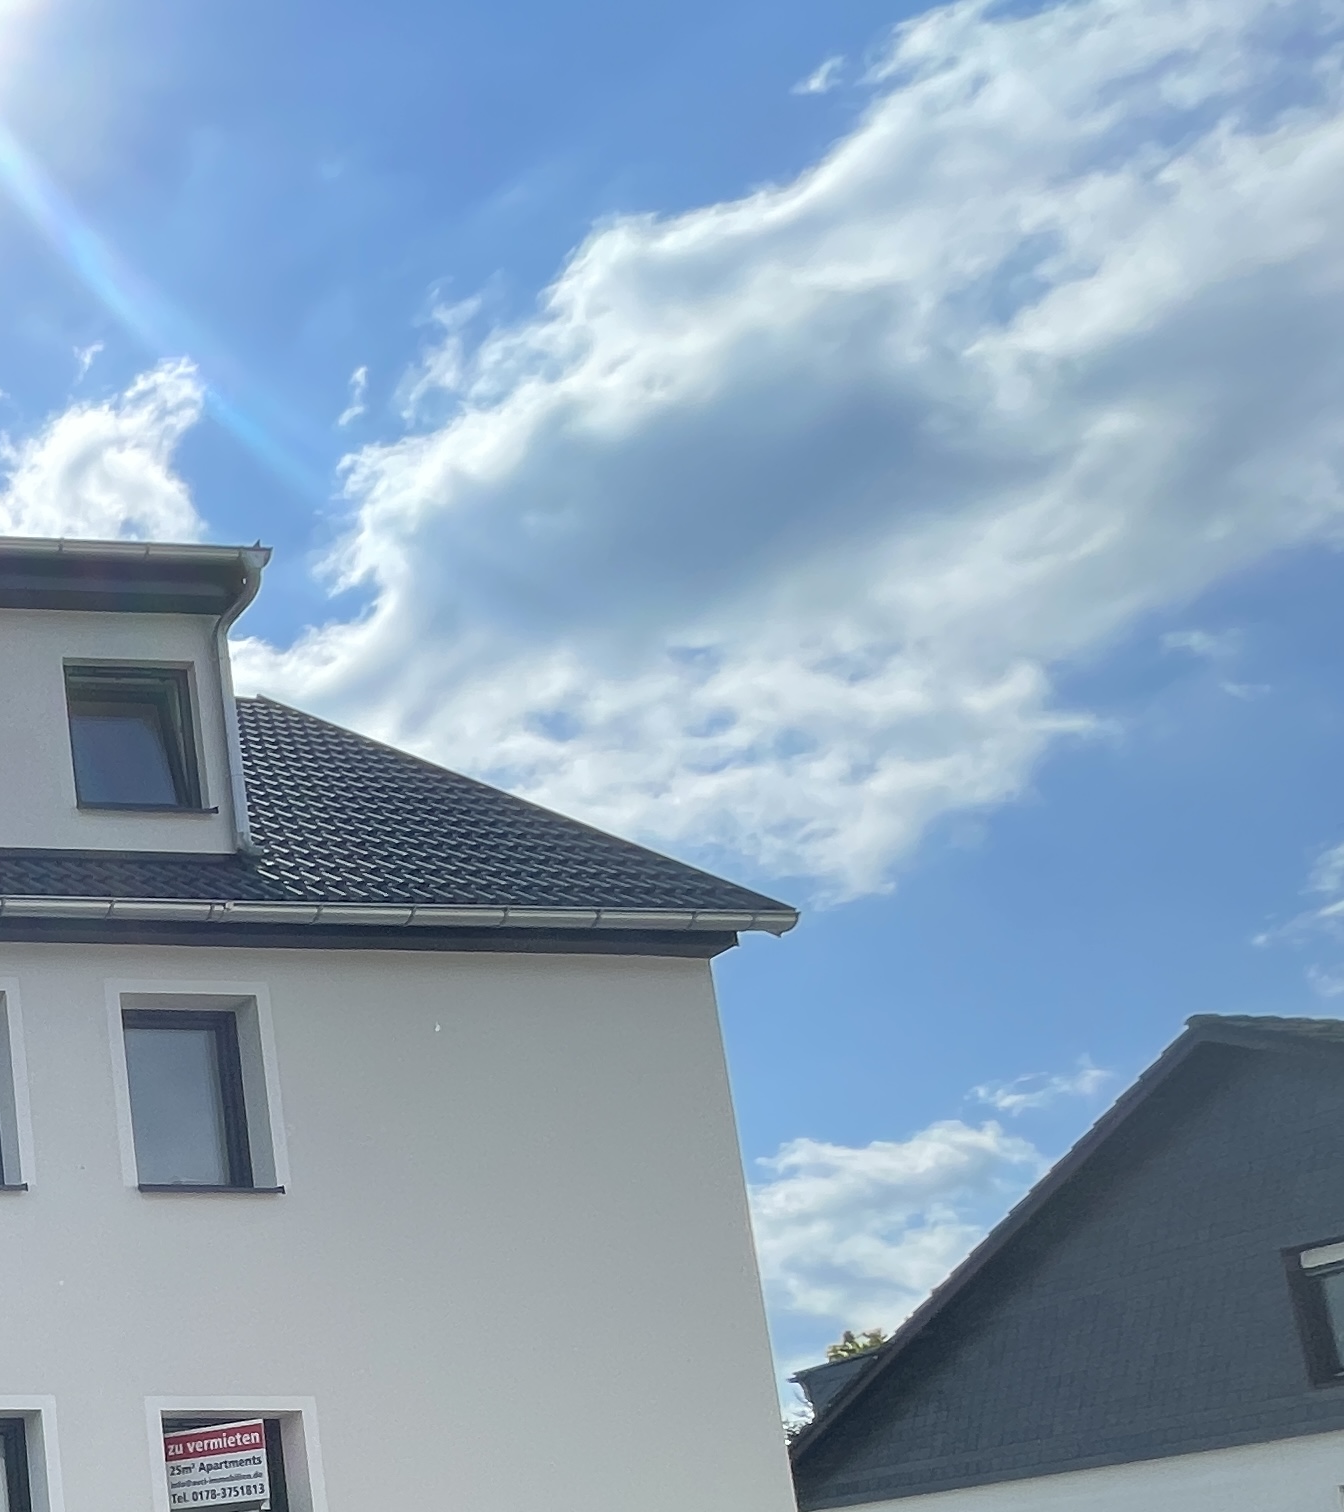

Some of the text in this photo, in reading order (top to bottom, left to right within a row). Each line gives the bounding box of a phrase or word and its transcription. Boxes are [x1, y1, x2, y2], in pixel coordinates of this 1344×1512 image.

[167, 1432, 260, 1456] zu vermieten
[169, 1455, 263, 1476] 25m² Apartments
[172, 1483, 266, 1504] Tel. 0178-3751813
